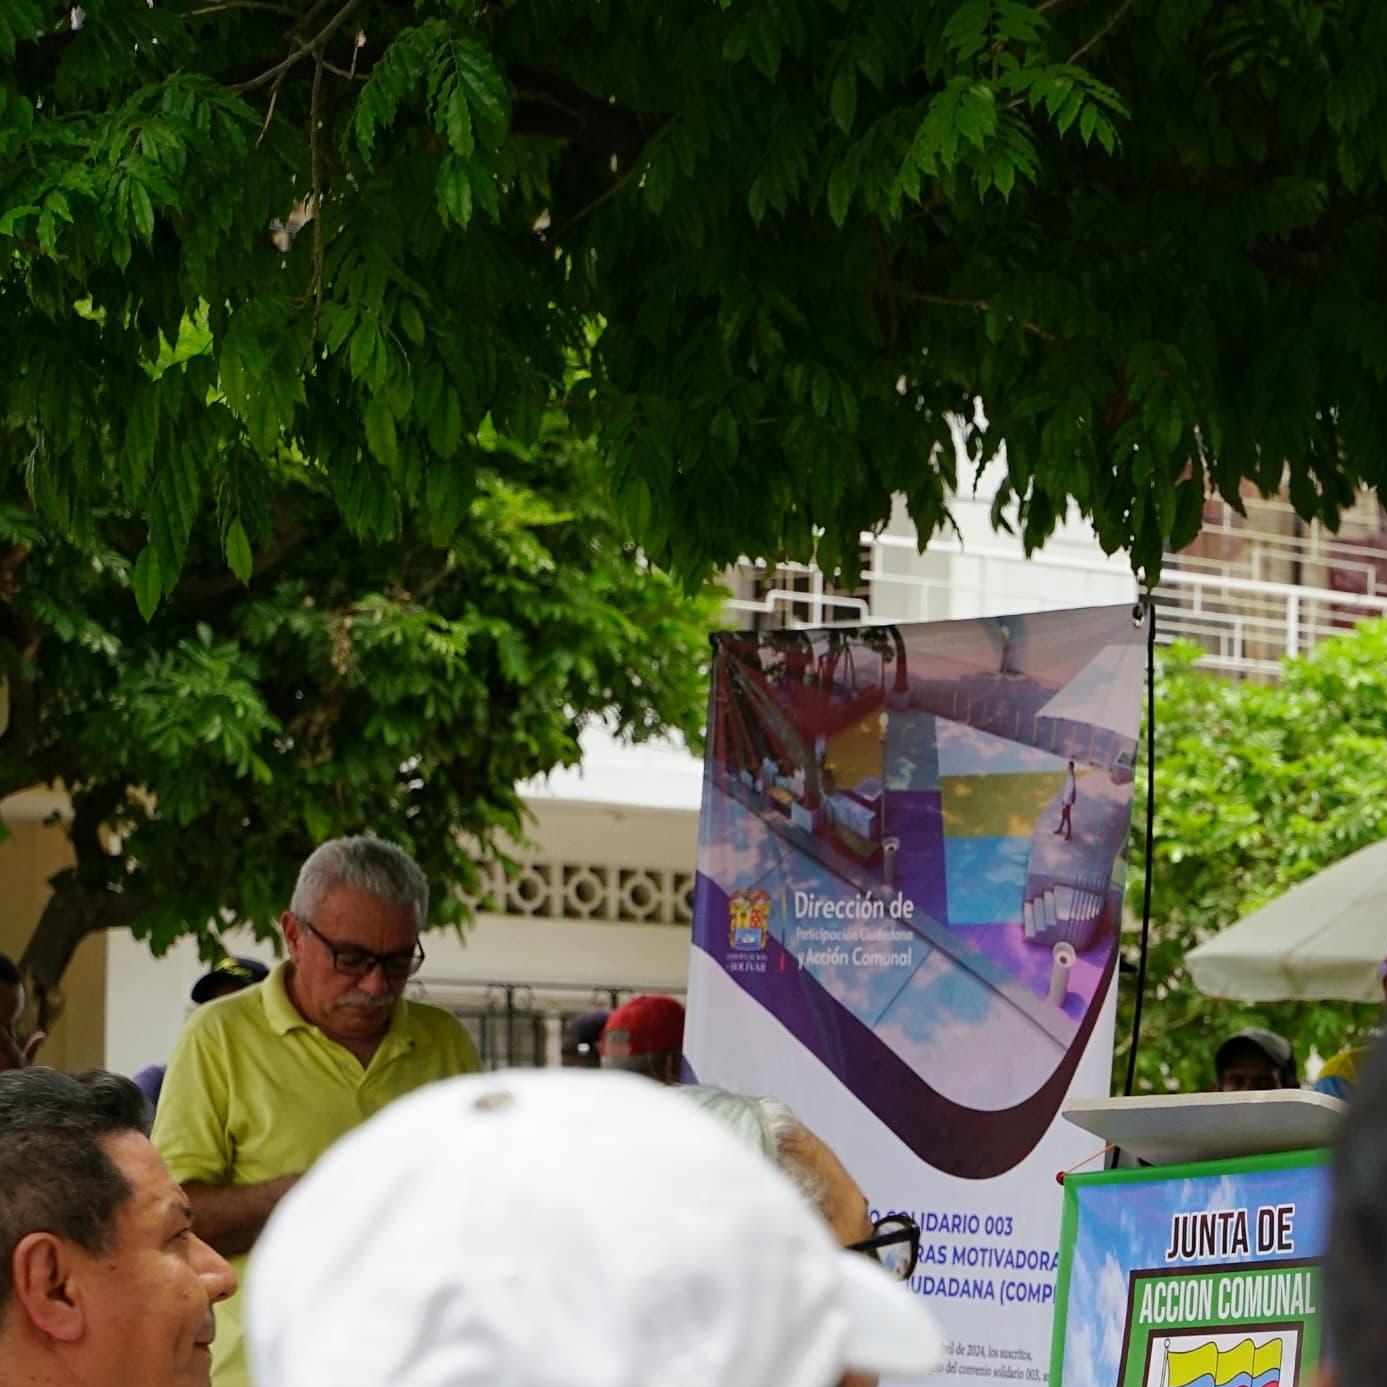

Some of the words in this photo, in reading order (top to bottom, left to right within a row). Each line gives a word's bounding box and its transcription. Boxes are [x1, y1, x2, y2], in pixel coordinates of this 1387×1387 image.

[795, 891, 884, 918] Dirección
[890, 891, 914, 918] de
[798, 955, 804, 969] y
[806, 949, 848, 965] Acción
[853, 949, 912, 965] Comunal
[985, 1216, 1013, 1236] 003
[1168, 1210, 1248, 1259] JUNTA
[1258, 1207, 1293, 1252] DE
[917, 1244, 947, 1264] RAS
[906, 1276, 995, 1299] UDADANA
[1000, 1281, 1056, 1306] (COMP
[1139, 1279, 1213, 1324] ACCION
[1218, 1272, 1316, 1319] COMUNAL
[956, 1342, 965, 1356] de
